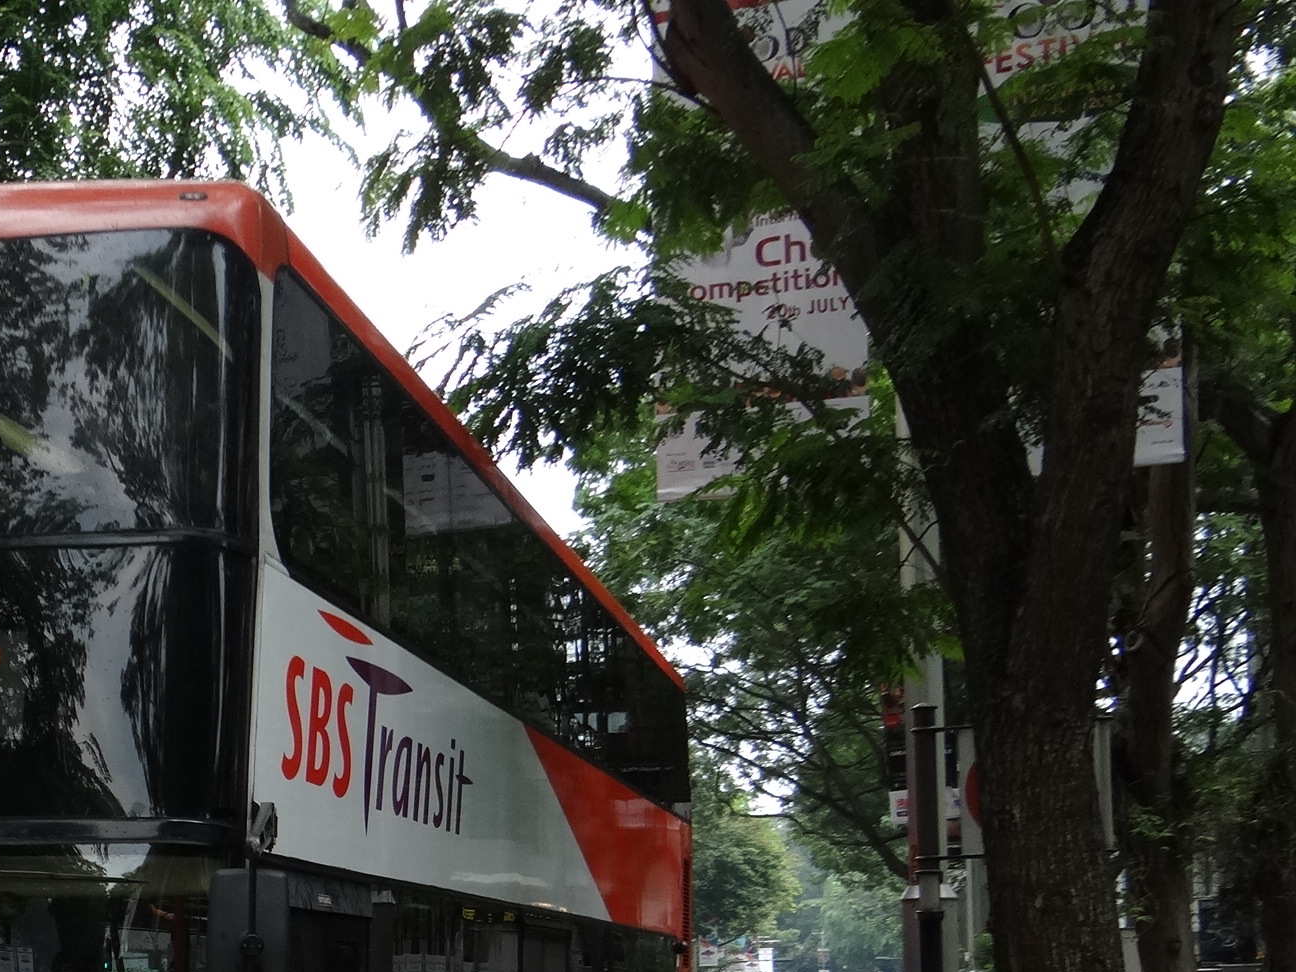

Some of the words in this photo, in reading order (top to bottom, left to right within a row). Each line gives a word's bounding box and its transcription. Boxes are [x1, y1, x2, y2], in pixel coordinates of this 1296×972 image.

[690, 267, 846, 303] ompetition
[807, 295, 851, 315] JULY
[281, 656, 355, 798] SBS
[345, 656, 474, 836] Transit
